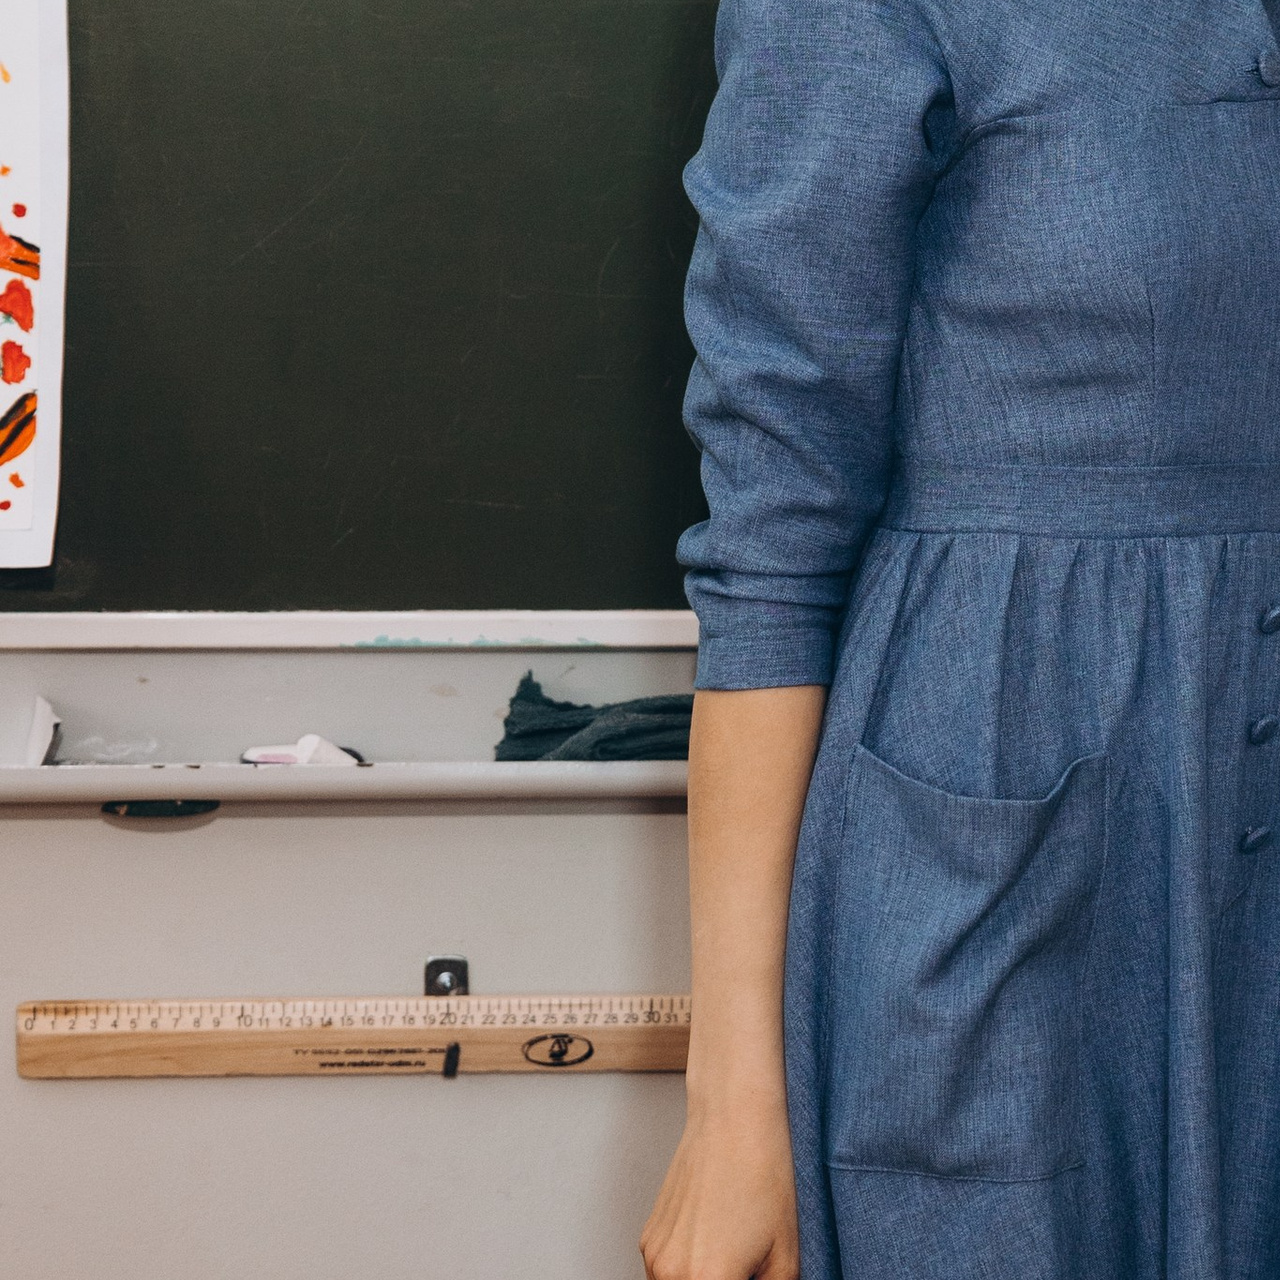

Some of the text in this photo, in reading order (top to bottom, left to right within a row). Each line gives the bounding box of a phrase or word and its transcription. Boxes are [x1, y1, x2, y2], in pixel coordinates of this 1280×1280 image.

[24, 1018, 34, 1030] 0
[51, 1020, 55, 1029] 1
[68, 1020, 76, 1029] 2
[90, 1020, 97, 1029] 3
[111, 1019, 118, 1028] 4
[130, 1019, 137, 1028] 5
[151, 1019, 158, 1028] 6
[173, 1019, 180, 1028] 7
[193, 1018, 200, 1027] 8
[213, 1018, 220, 1027] 9
[238, 1016, 252, 1027] 10
[259, 1018, 269, 1027] 11
[280, 1017, 292, 1027] 12
[301, 1017, 313, 1026] 13
[341, 1016, 353, 1026] 15
[361, 1016, 374, 1026] 16
[382, 1015, 394, 1025] 17
[402, 1015, 415, 1025] 18
[423, 1015, 436, 1025] 19
[440, 1013, 457, 1025] 20
[461, 1014, 474, 1024] 21
[481, 1014, 496, 1024] 22
[502, 1014, 517, 1024] 23
[522, 1014, 536, 1024] 24
[543, 1014, 557, 1024] 25
[563, 1013, 578, 1024] 26
[583, 1013, 598, 1024] 27
[603, 1013, 618, 1024] 28
[623, 1013, 639, 1024] 29
[643, 1011, 660, 1023] 30
[663, 1013, 678, 1023] 31
